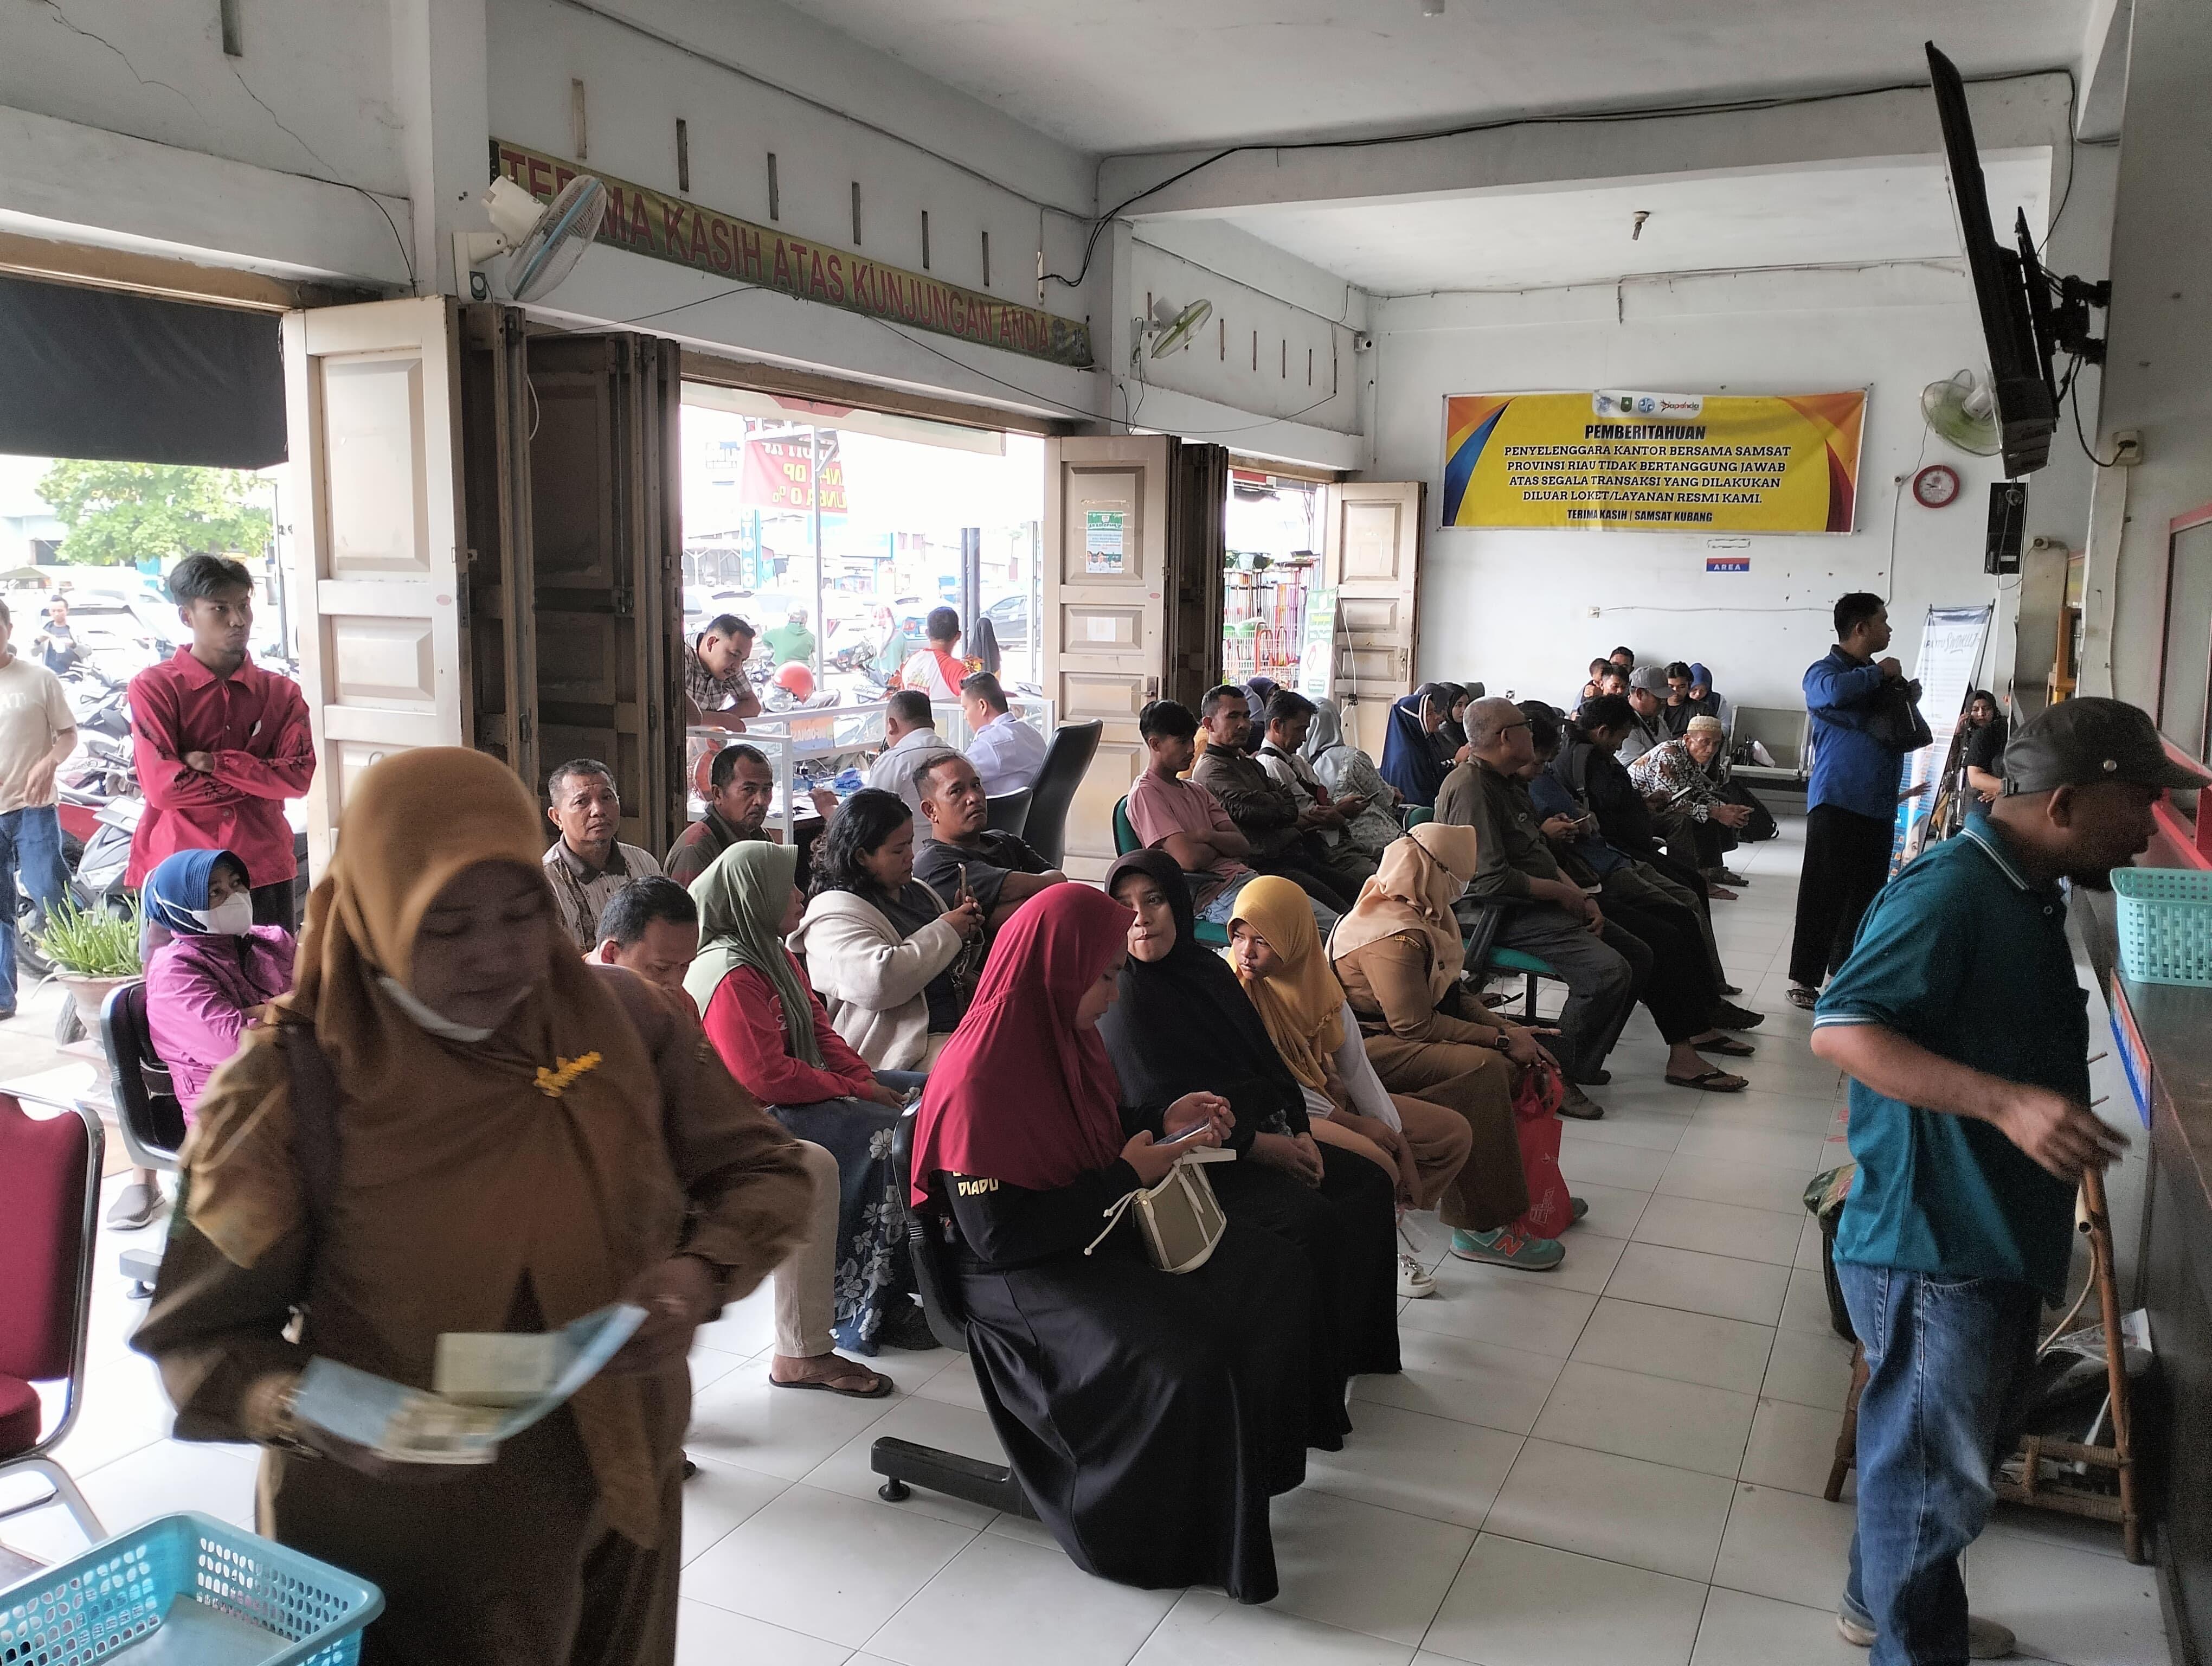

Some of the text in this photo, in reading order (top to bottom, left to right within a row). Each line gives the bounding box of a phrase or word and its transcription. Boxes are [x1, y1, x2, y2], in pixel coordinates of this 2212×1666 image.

[499, 148, 1051, 353] TEMA KASIH ATAS KUNJUNGAN ANDA
[1585, 425, 1706, 440] PEMBERITAHUAN
[1504, 445, 1791, 456] PENYELENGGARA KANTOR BERSAMA SAMSAT
[1507, 461, 1785, 473] PROVINSI RIAU TIDAK BERTANGGUNG JAWAB
[1509, 476, 1780, 488] ATAS SEGALA TRANSAKSI YANG DILAKUKAN
[1523, 491, 1762, 503] DILUAR LOKET/LAYANAN RESMI KAMI.
[1567, 509, 1713, 522] TERIMA KASIH SAMSAT KUBANG
